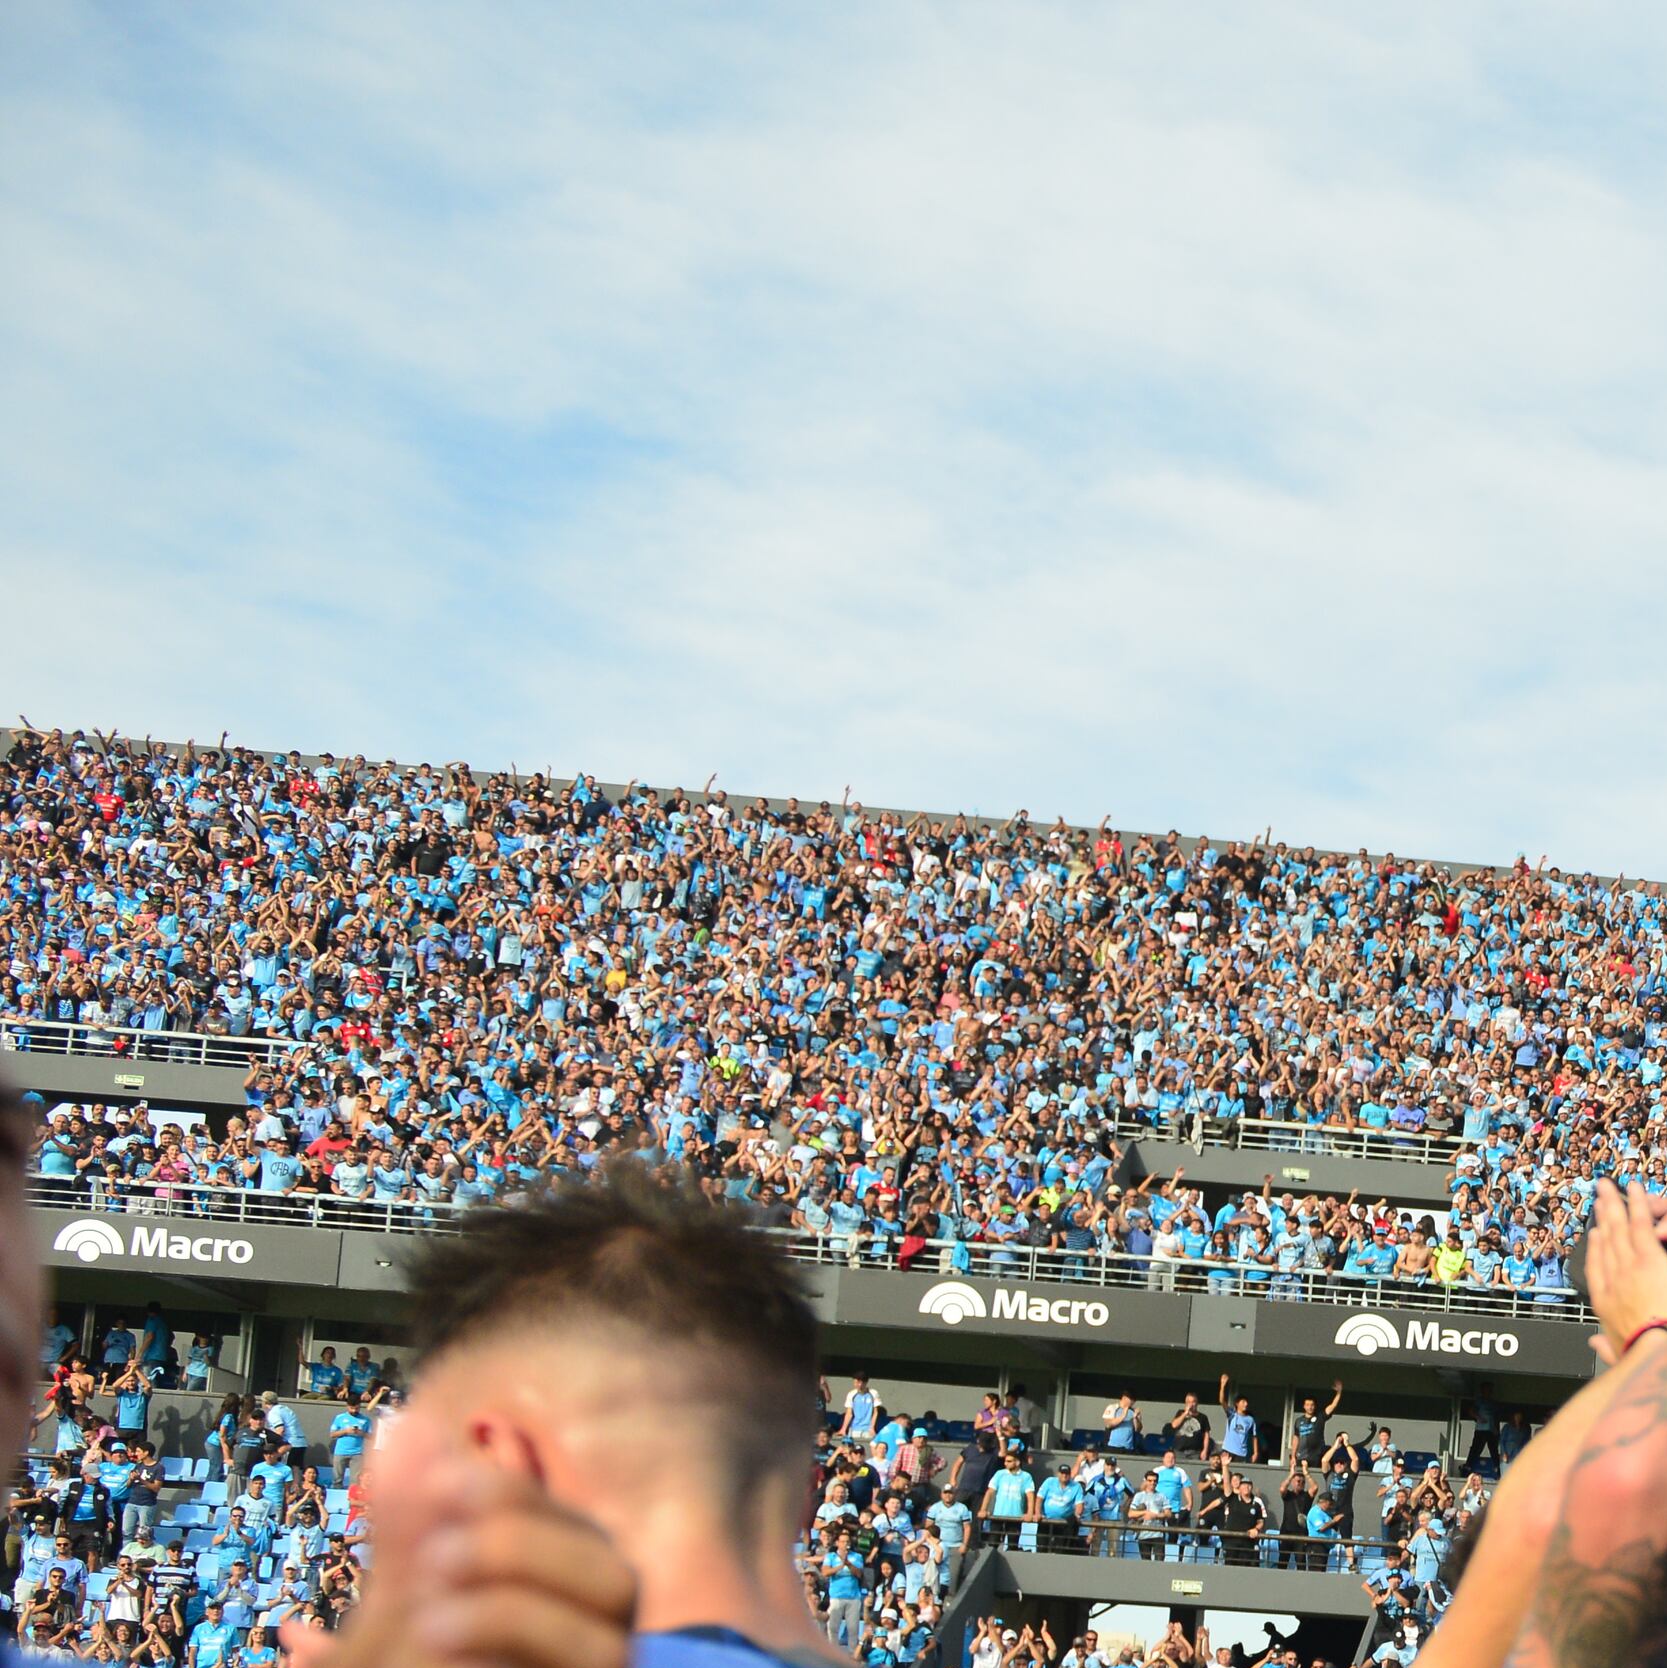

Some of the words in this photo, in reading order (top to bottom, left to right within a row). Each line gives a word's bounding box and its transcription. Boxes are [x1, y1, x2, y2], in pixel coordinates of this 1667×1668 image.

[130, 1226, 254, 1264] Macro
[992, 1288, 1110, 1327] Macro
[1405, 1320, 1519, 1357] Macro
